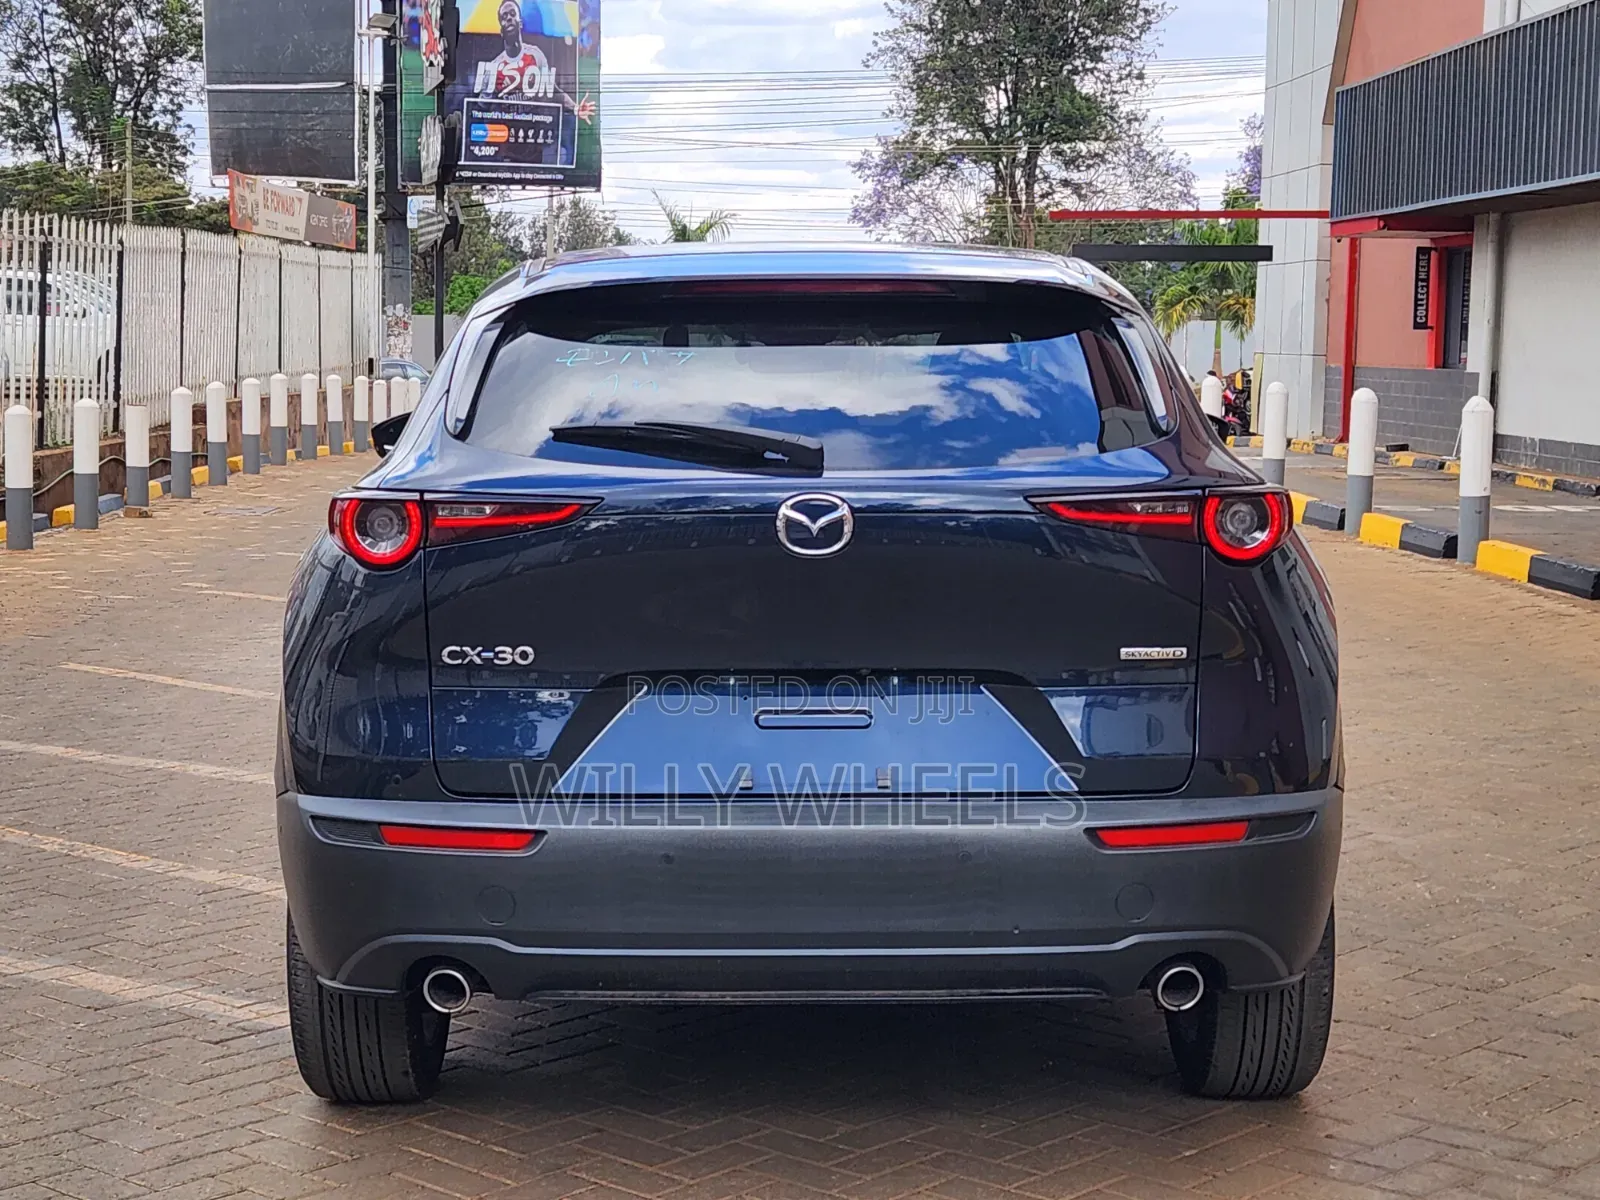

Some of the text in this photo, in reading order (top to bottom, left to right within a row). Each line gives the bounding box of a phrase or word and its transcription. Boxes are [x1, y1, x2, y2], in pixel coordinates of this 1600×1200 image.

[473, 61, 557, 98] IT'S ON
[532, 115, 553, 124] package
[1416, 254, 1428, 323] COLLECT HERE
[441, 645, 535, 666] CX-30
